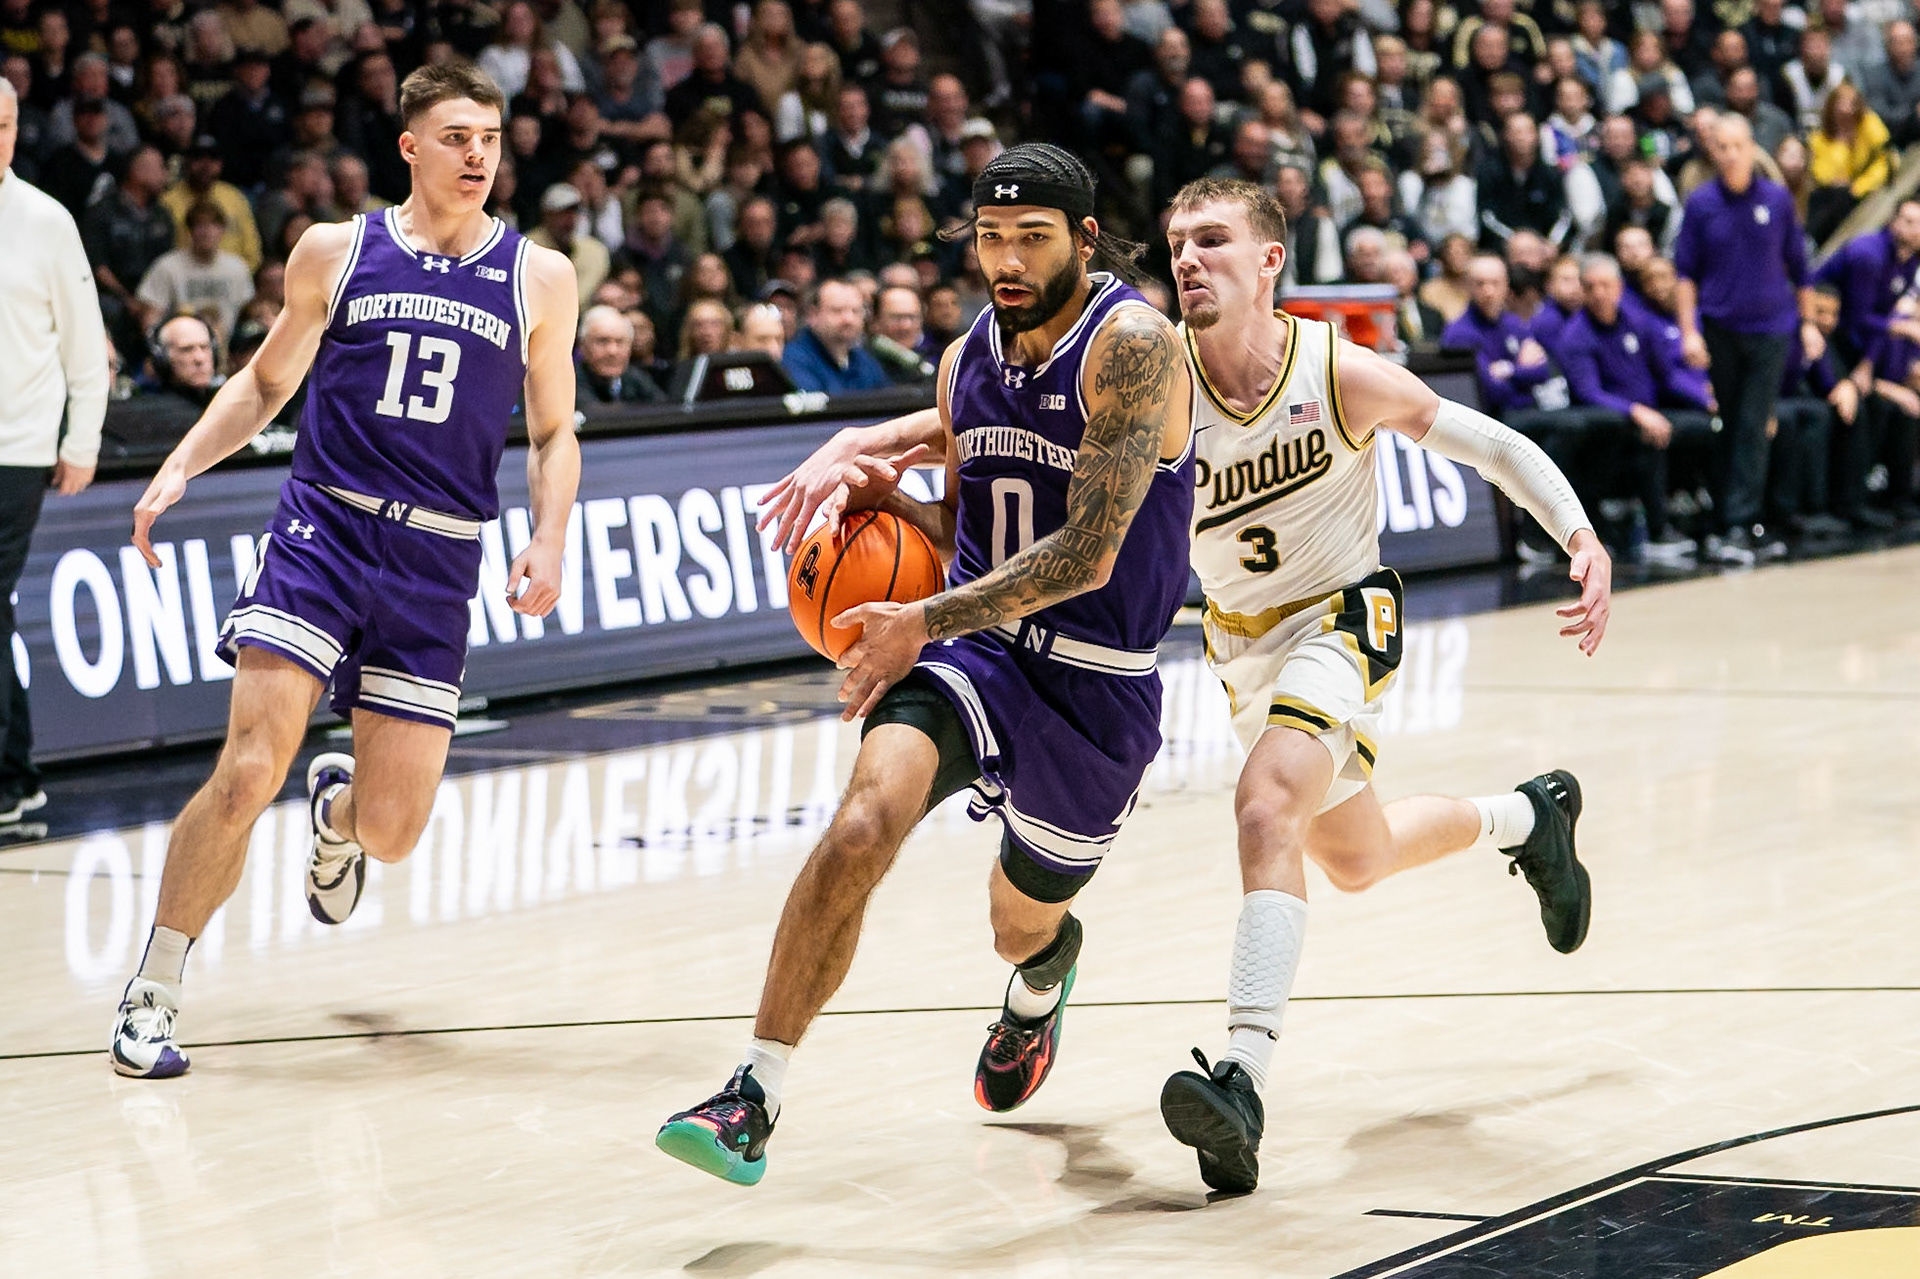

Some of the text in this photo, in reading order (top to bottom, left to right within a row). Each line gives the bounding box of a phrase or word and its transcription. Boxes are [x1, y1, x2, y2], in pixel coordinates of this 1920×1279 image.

[347, 293, 511, 350] NORTHWESTERN
[375, 331, 462, 424] 13
[386, 500, 408, 521] N
[992, 478, 1034, 569] 0
[468, 482, 800, 647] NIVERSIT
[796, 541, 822, 600] P
[1030, 549, 1097, 586] RICHES
[1237, 525, 1281, 573] 3
[1024, 623, 1047, 653] N
[1360, 587, 1397, 653] P
[143, 991, 154, 1008] N
